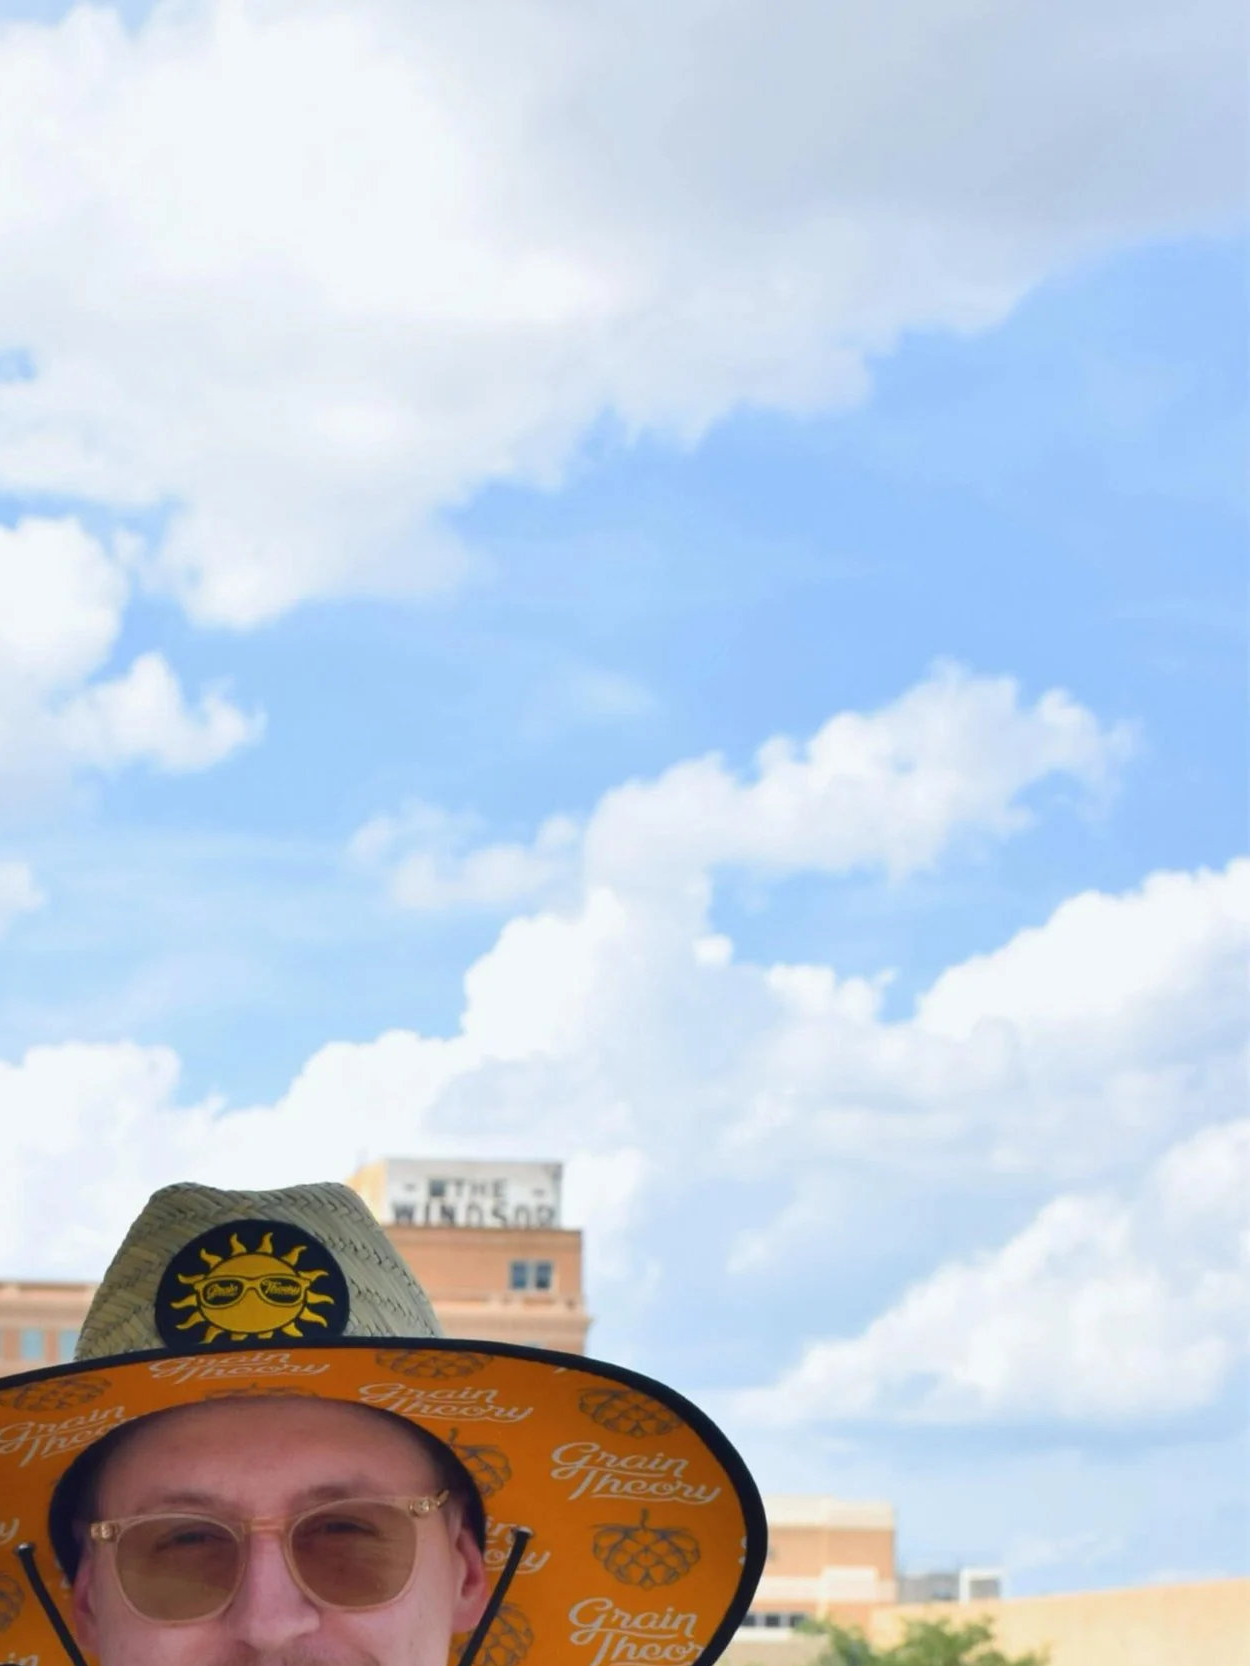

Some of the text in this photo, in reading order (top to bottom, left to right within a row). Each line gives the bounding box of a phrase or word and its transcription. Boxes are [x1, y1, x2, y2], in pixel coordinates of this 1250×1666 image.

[452, 1178, 507, 1197] THE
[393, 1203, 556, 1228] WINDSOR
[149, 1351, 292, 1380] Grain
[173, 1359, 331, 1385] Theory
[358, 1382, 499, 1406] Grain
[550, 1441, 690, 1481] Grain
[567, 1470, 723, 1506] Theory
[568, 1597, 699, 1646] Grain
